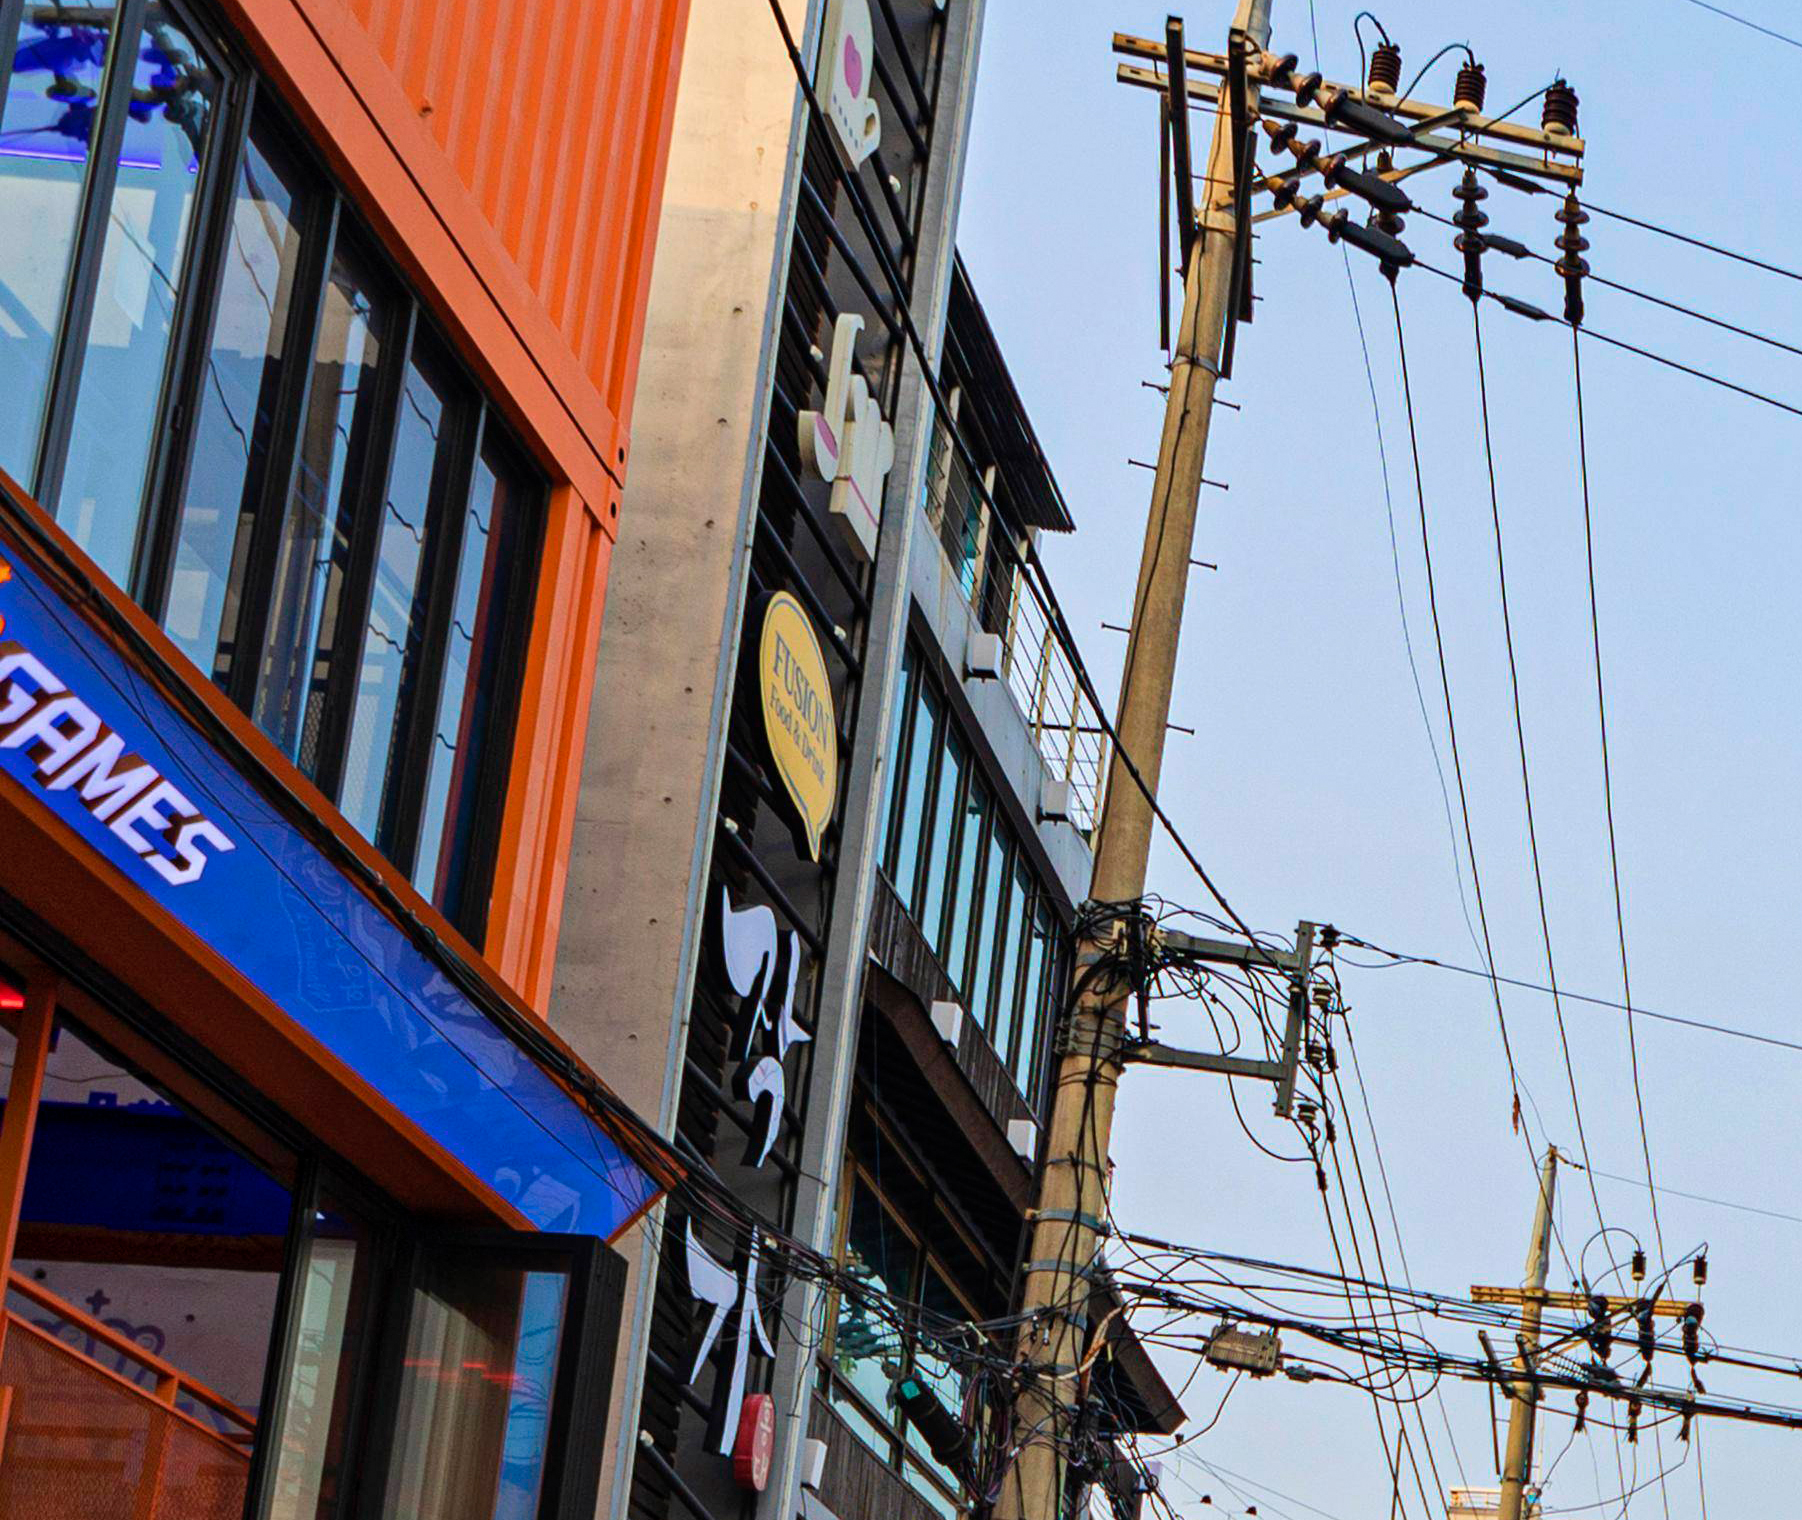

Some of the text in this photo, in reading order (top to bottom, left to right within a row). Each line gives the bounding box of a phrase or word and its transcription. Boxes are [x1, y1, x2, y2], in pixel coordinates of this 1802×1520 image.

[769, 681, 792, 736] Food
[773, 630, 828, 752] FUSION
[0, 650, 235, 886] GAMES
